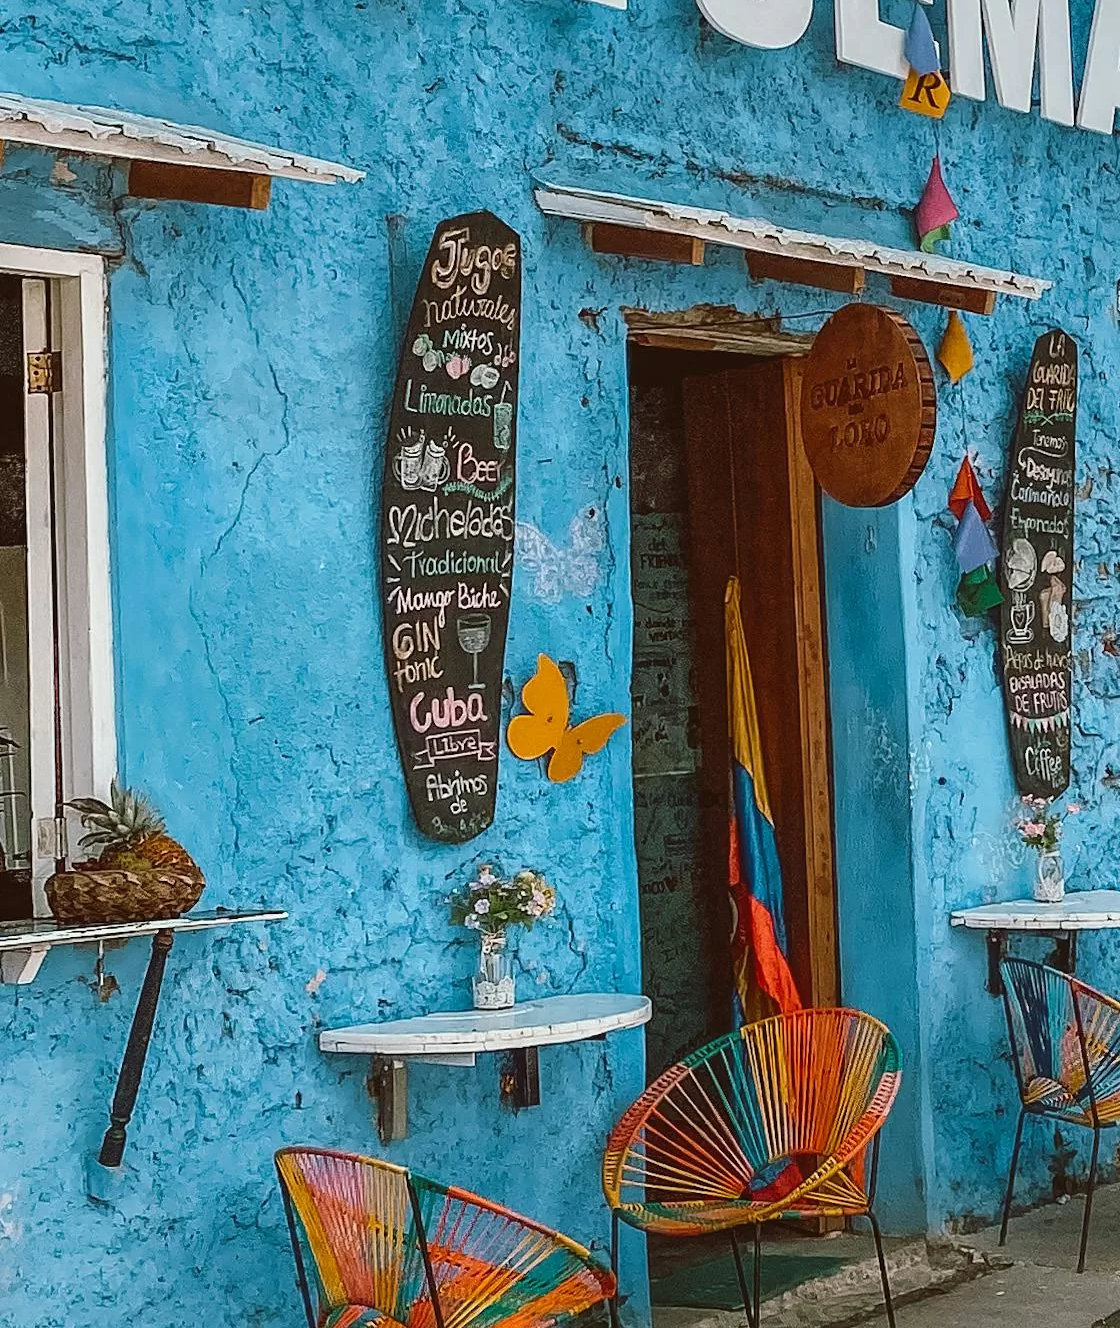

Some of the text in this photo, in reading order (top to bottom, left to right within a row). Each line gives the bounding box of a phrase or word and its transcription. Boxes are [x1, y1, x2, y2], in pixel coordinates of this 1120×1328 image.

[907, 71, 941, 110] R
[431, 226, 517, 296] Jugos
[422, 284, 516, 332] naturales
[442, 323, 495, 356] Mixtos
[1048, 333, 1066, 359] LA
[809, 361, 909, 411] GUARIDA
[1031, 360, 1076, 388] GUARIDA
[404, 378, 495, 418] Limonadas
[1026, 387, 1045, 411] DEL
[387, 496, 514, 549] Micheladas
[402, 549, 503, 579] Tradicional
[396, 581, 502, 629] Mango Biche
[392, 616, 441, 660] GIN
[393, 655, 444, 692] tonic
[1008, 671, 1066, 694] ENSALADAS
[409, 685, 488, 734] Cuba
[1014, 689, 1068, 714] DE FRUTAS
[1024, 746, 1063, 782] Coffee
[425, 769, 488, 802] Abrimos
[449, 794, 468, 815] de
